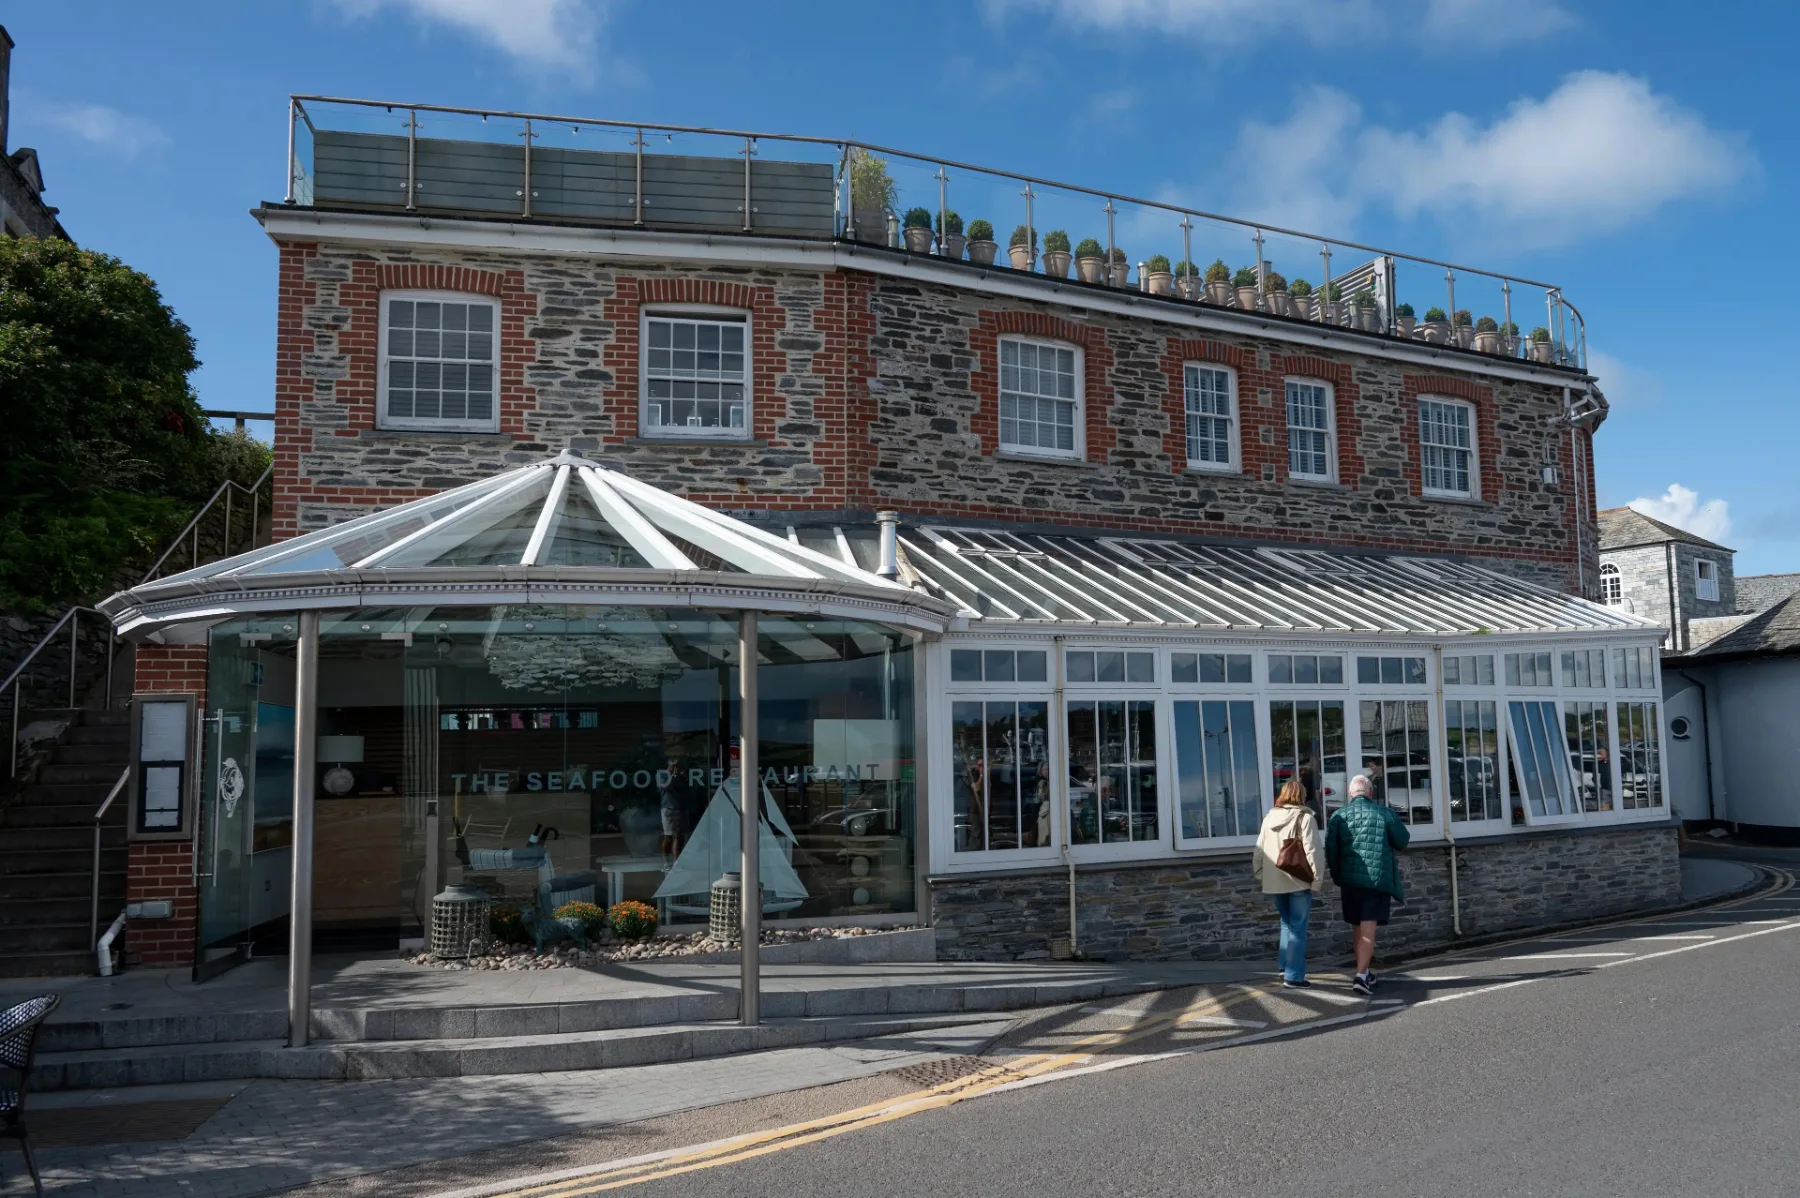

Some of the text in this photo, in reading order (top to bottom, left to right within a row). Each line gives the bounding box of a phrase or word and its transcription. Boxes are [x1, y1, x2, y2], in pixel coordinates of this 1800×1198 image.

[451, 763, 878, 793] THE SEAFOOD RESAURANT
